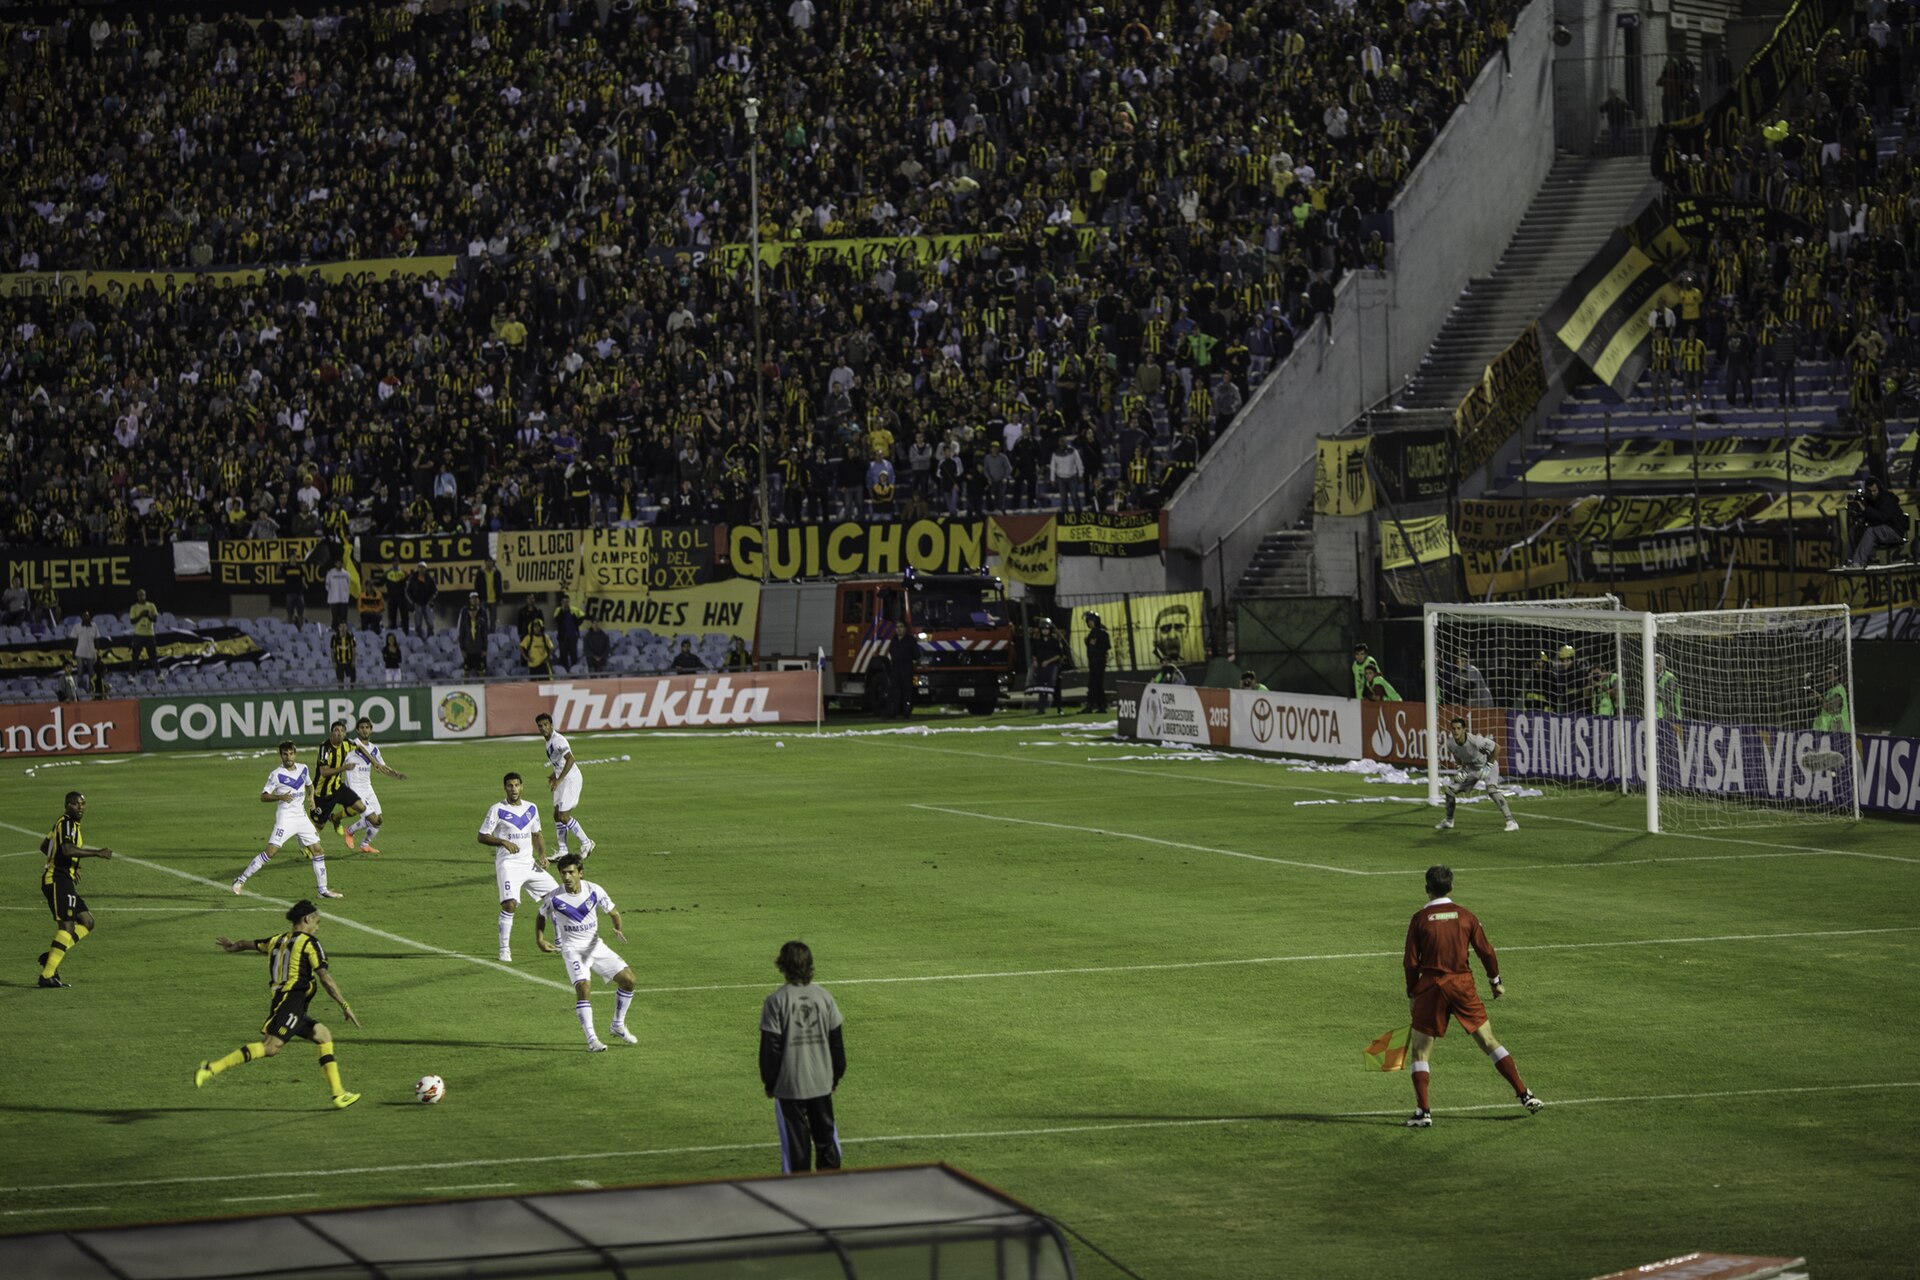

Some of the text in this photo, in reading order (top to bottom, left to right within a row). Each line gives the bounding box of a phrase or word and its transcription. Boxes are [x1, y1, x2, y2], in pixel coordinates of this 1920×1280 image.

[1463, 520, 1484, 534] DE
[379, 538, 473, 560] COETC
[518, 532, 574, 557] EL LOCO
[666, 552, 692, 566] DEL
[9, 555, 132, 591] MUERTE
[221, 565, 250, 585] EL
[516, 558, 575, 582] VINAGRE
[597, 566, 701, 589] SIGLO XX
[585, 597, 744, 628] GRANDES HAY
[1118, 699, 1137, 719] 2013
[1161, 692, 1176, 705] COPA
[150, 694, 422, 742] CONMEBOL
[1209, 706, 1229, 727] 2013
[1276, 705, 1341, 745] TOYOTA
[1162, 722, 1199, 738] LIBERTADORES
[1673, 722, 1746, 793] VISA
[1758, 729, 1834, 802] VISA
[275, 827, 285, 838] 16
[504, 880, 511, 891] 6
[572, 960, 581, 972] 3
